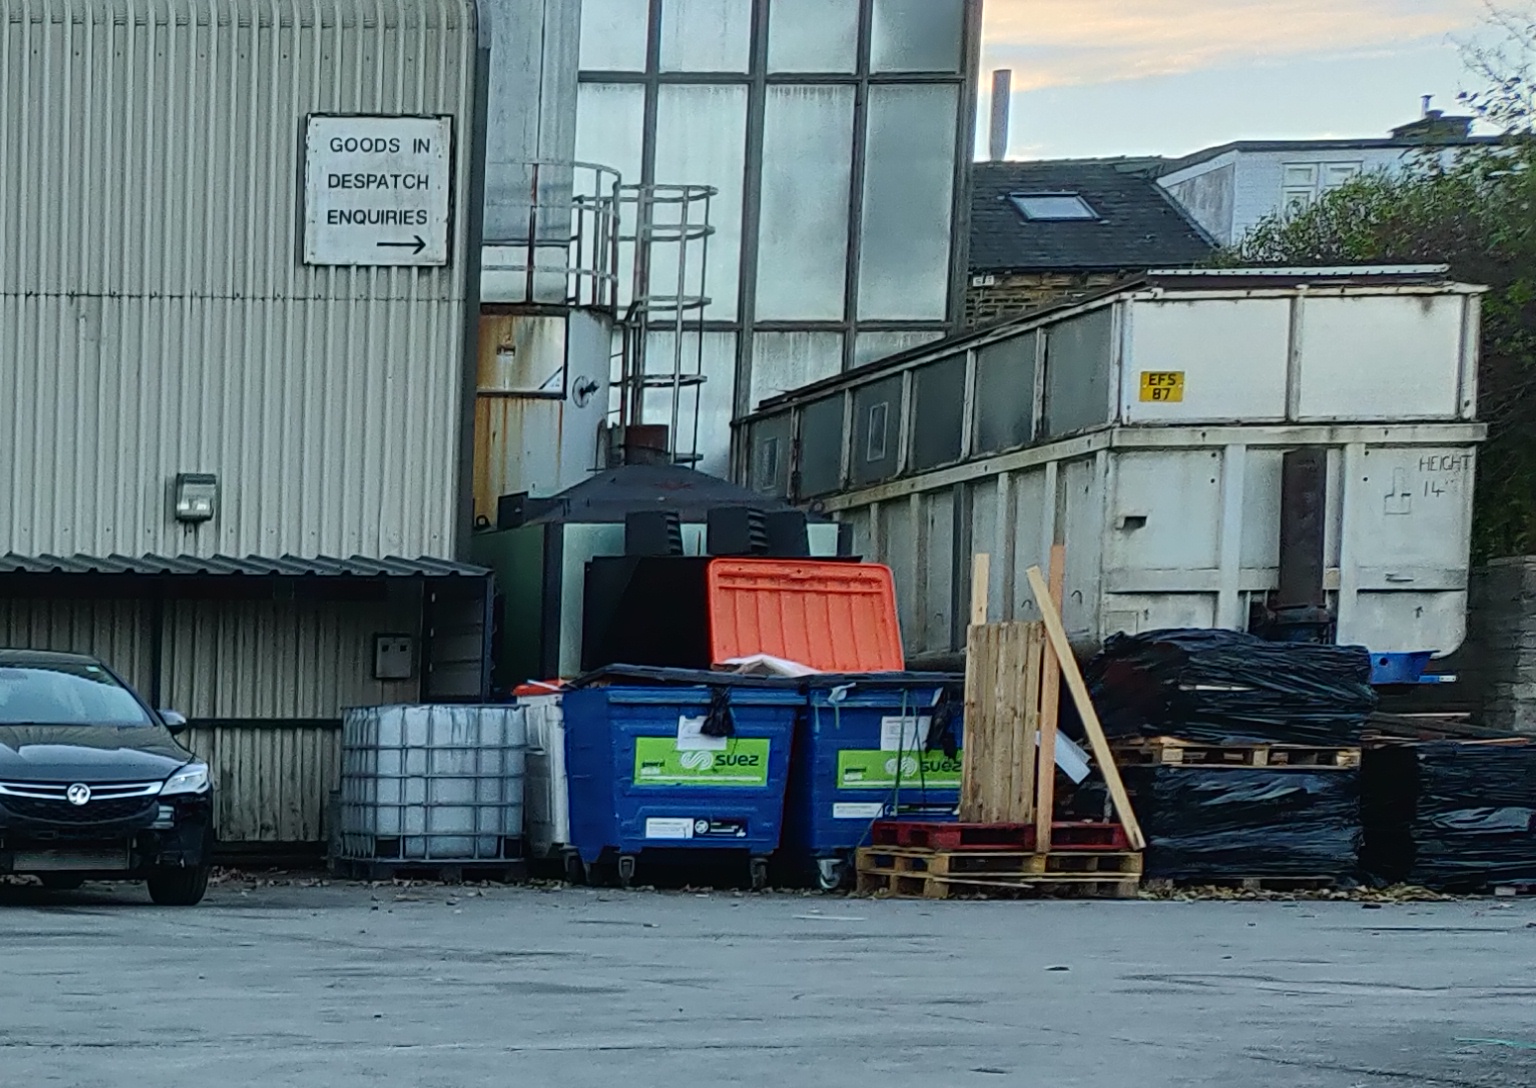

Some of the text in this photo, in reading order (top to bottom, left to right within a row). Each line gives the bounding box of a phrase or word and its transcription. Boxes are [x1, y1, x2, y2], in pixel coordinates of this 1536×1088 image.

[329, 137, 431, 154] GOODS IN
[327, 173, 430, 190] DESPATCH
[327, 208, 428, 226] ENQUIRIES
[1148, 373, 1177, 386] EFS
[1152, 387, 1171, 401] 87
[1419, 455, 1473, 472] HEIGHT
[714, 753, 760, 767] suez
